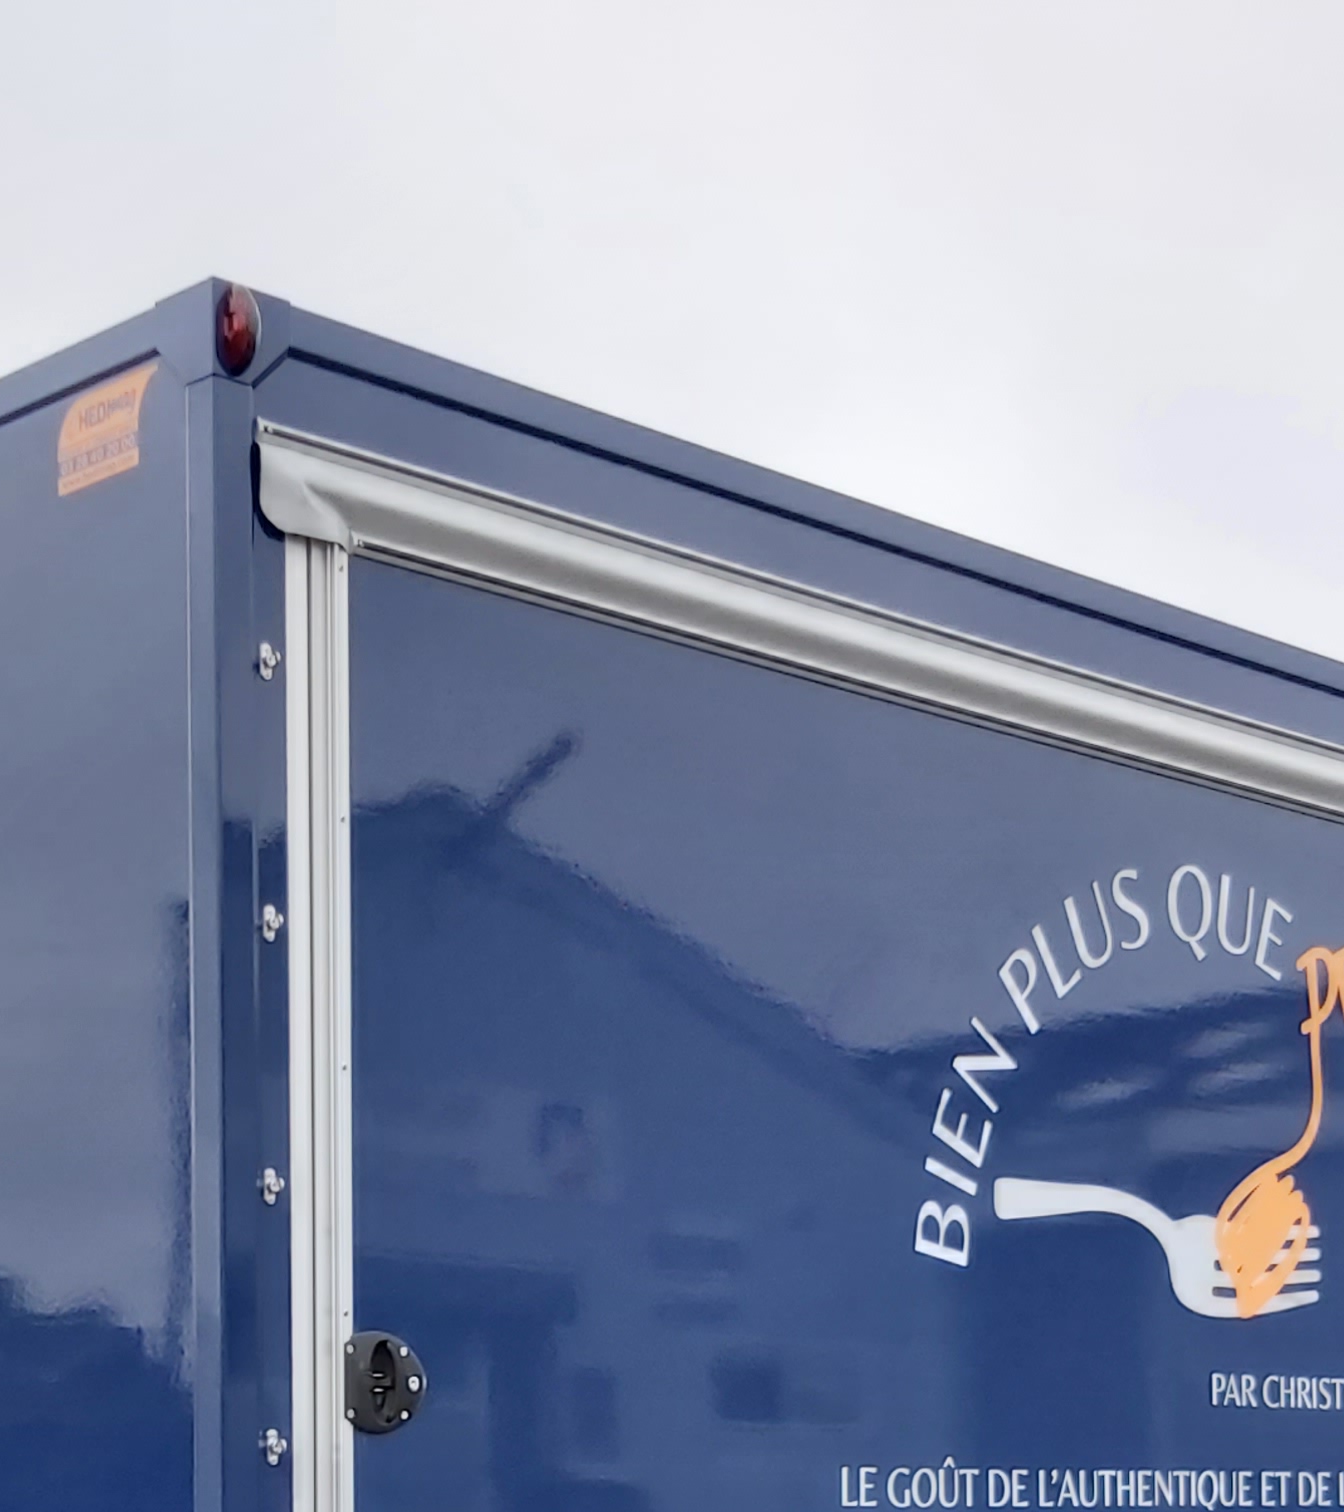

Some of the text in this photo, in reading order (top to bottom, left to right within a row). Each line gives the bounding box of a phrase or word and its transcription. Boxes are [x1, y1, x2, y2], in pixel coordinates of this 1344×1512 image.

[914, 1017, 1017, 1267] BIEN
[998, 869, 1151, 1034] PLUS
[1166, 864, 1294, 981] QUE
[1210, 1373, 1258, 1408] PAR
[841, 1466, 878, 1508] LE
[887, 1456, 980, 1509] GOÛT
[988, 1468, 1029, 1508] DE
[1038, 1468, 1253, 1511] L'AUTHENTIQUE
[1260, 1470, 1291, 1507] ET
[1298, 1471, 1331, 1507] DE
